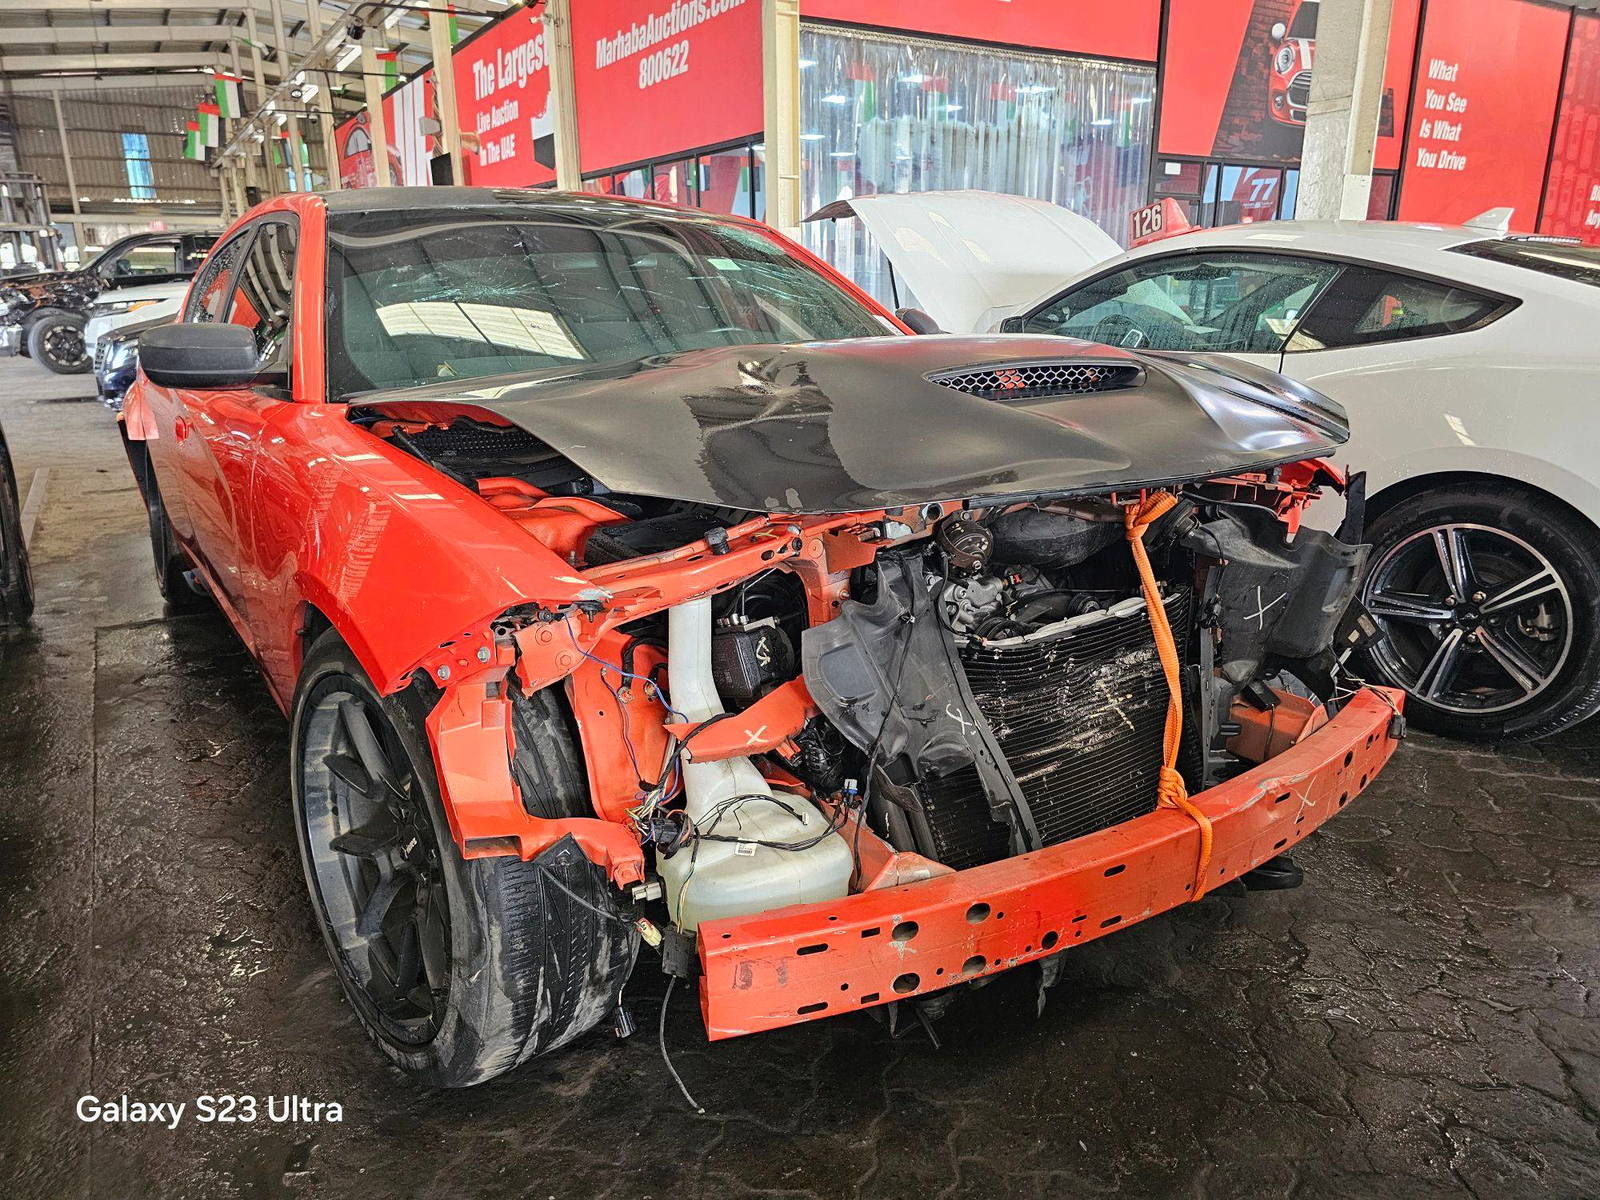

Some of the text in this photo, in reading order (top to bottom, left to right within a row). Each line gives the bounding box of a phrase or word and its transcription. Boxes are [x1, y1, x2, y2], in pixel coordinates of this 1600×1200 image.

[638, 40, 690, 90] 800622
[1428, 58, 1459, 82] What
[473, 59, 496, 101] The
[1424, 88, 1468, 113] You See
[477, 99, 519, 134] Live Auction
[1419, 118, 1462, 142] Is What
[487, 141, 501, 164] The
[501, 133, 516, 161] UAE
[1416, 147, 1467, 171] You Drive
[1249, 177, 1279, 202] 77
[1133, 205, 1163, 239] 126
